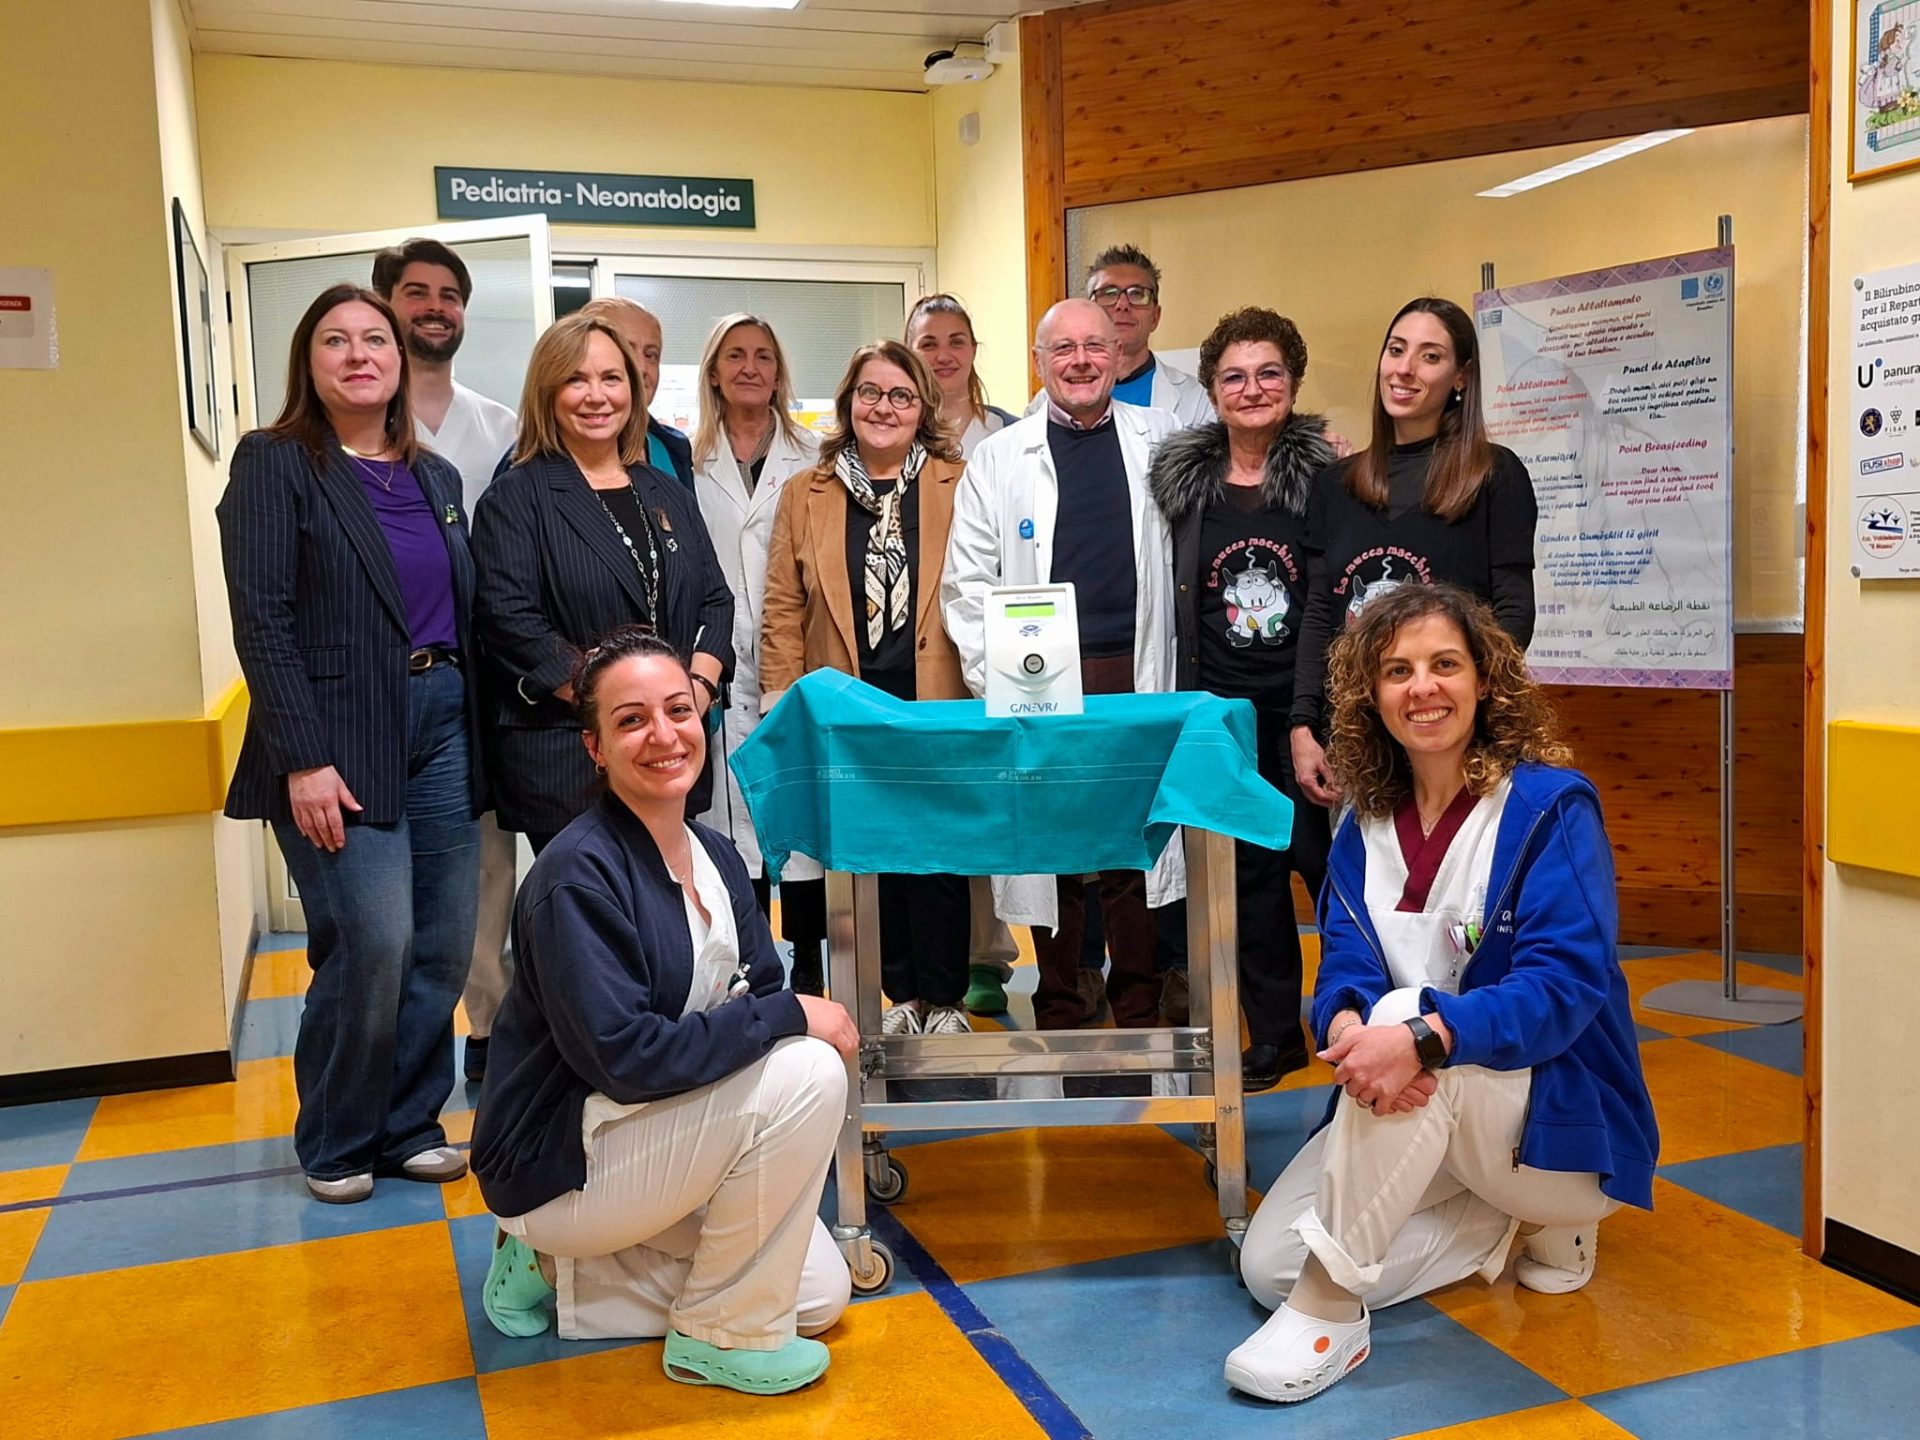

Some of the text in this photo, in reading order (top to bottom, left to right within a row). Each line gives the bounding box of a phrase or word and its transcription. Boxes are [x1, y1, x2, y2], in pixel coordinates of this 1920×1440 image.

[451, 177, 561, 206] Pediatria
[577, 183, 741, 217] Neonatologia
[1865, 283, 1920, 301] Il Bilirubino
[1577, 294, 1642, 312] Allattamento
[1862, 306, 1878, 319] per
[1881, 302, 1887, 313] il
[1860, 316, 1909, 332] acquistato
[1623, 363, 1648, 375] Punct
[1651, 362, 1662, 371] de
[1619, 444, 1642, 454] Point
[1212, 540, 1246, 569] mucca
[1248, 537, 1298, 582] macchiata
[1345, 547, 1384, 575] mucca
[1386, 546, 1435, 590] macchia
